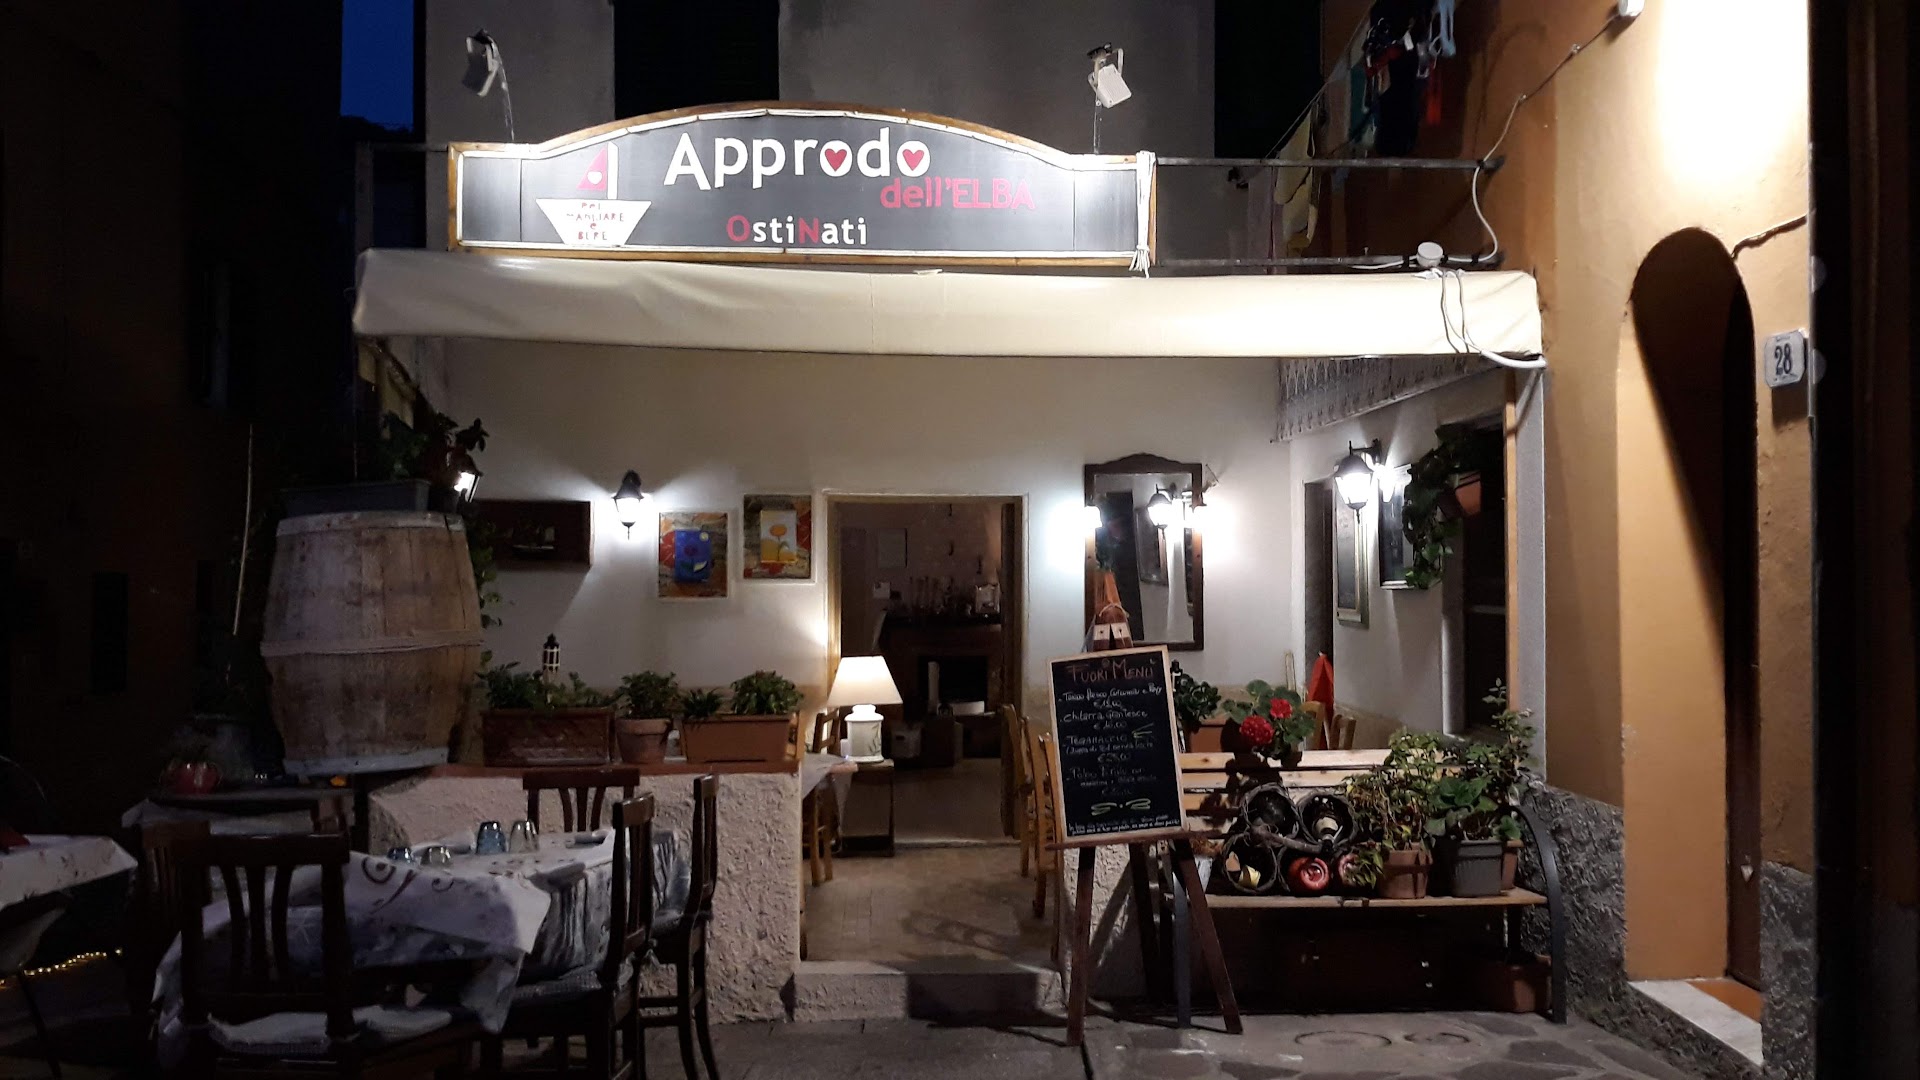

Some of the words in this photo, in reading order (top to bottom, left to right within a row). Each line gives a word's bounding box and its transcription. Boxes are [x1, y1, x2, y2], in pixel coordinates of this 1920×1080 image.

[663, 126, 932, 191] Approdo
[880, 175, 1036, 209] dell'ELBA
[726, 214, 868, 245] OstiNati
[1774, 343, 1792, 375] 28
